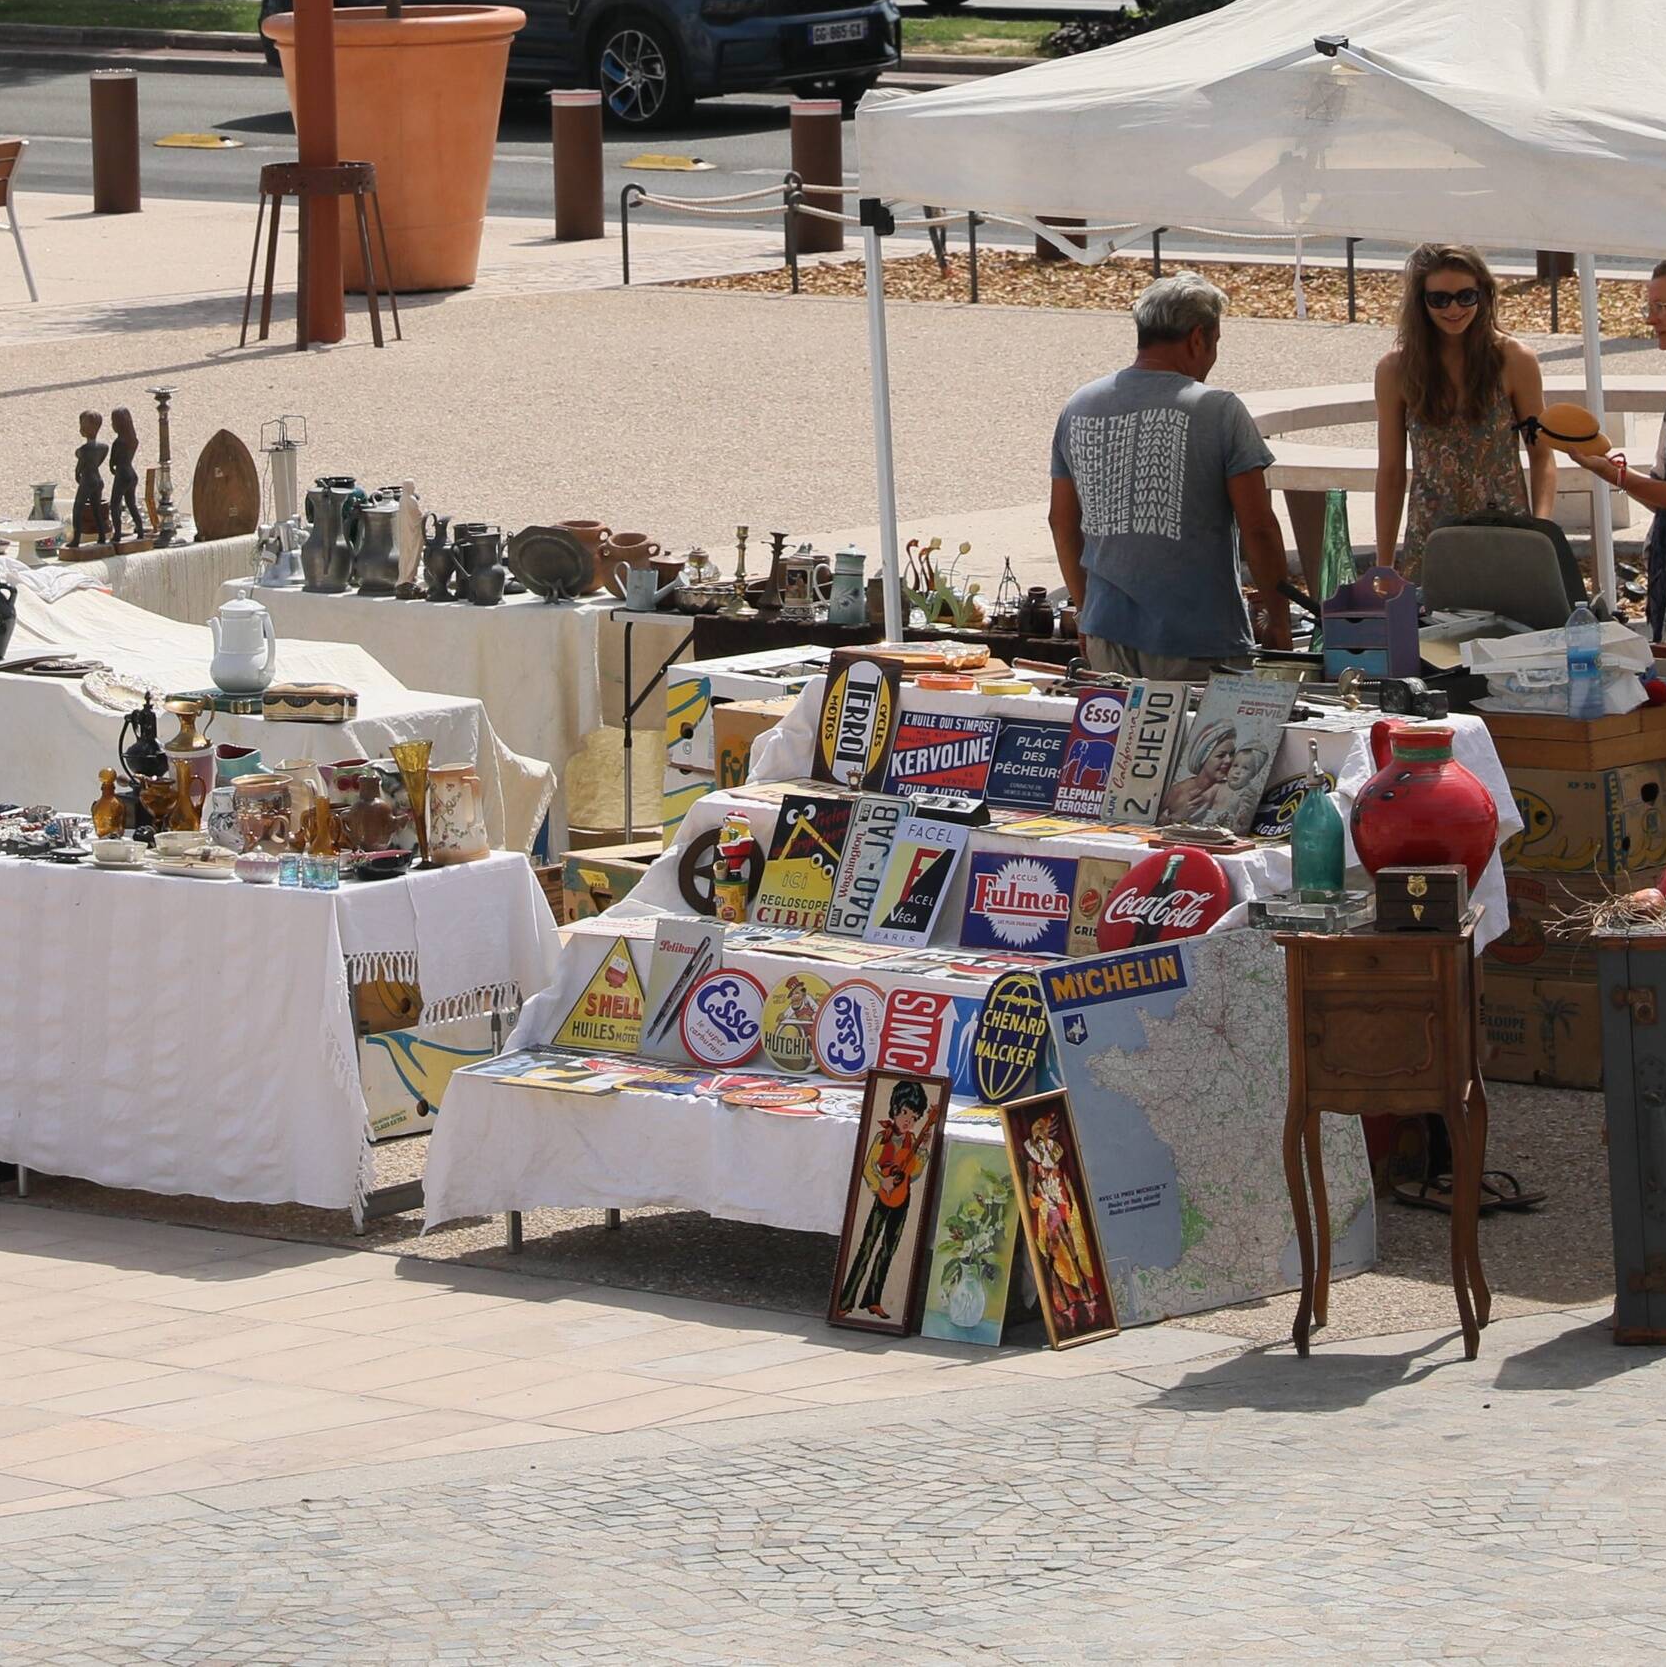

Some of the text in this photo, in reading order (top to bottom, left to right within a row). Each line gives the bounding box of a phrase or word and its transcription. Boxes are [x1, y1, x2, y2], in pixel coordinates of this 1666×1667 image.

[1109, 412, 1139, 430] THE
[1142, 408, 1189, 429] WAVES
[1107, 428, 1136, 441] THE
[1132, 517, 1181, 540] WAVES
[824, 695, 839, 741] MOTOS
[1237, 706, 1284, 719] FORVIL
[835, 675, 882, 774] TERROT
[874, 703, 888, 748] CYCLES
[904, 715, 941, 728] L'HUILE
[955, 719, 995, 734] S'IMPOSE
[1016, 736, 1062, 751] PLACE
[1112, 708, 1141, 789] California
[1124, 692, 1175, 815] 2 CHEVO
[890, 737, 993, 778] KERVOLINE
[1022, 751, 1047, 762] DES
[897, 783, 970, 799] POUR AUTOS
[1054, 799, 1102, 815] KEROSEN
[1106, 795, 1118, 816] JUN
[907, 823, 954, 844] FACEL
[837, 830, 868, 899] Washington
[1010, 873, 1038, 883] ACCUS
[759, 893, 829, 911] REGLOSCOPE
[970, 872, 1070, 915] Fulmen
[1104, 887, 1215, 929] Coca-Cola
[659, 940, 697, 955] Pelikan
[874, 931, 916, 943] PARIS
[1050, 954, 1178, 1003] MICHELIN
[584, 992, 642, 1021] SHELL
[572, 1020, 615, 1041] HUILES
[984, 1009, 1046, 1037] CHENARD
[689, 1025, 724, 1057] carburant
[704, 1028, 727, 1048] super
[975, 1039, 1037, 1068] WALCKER
